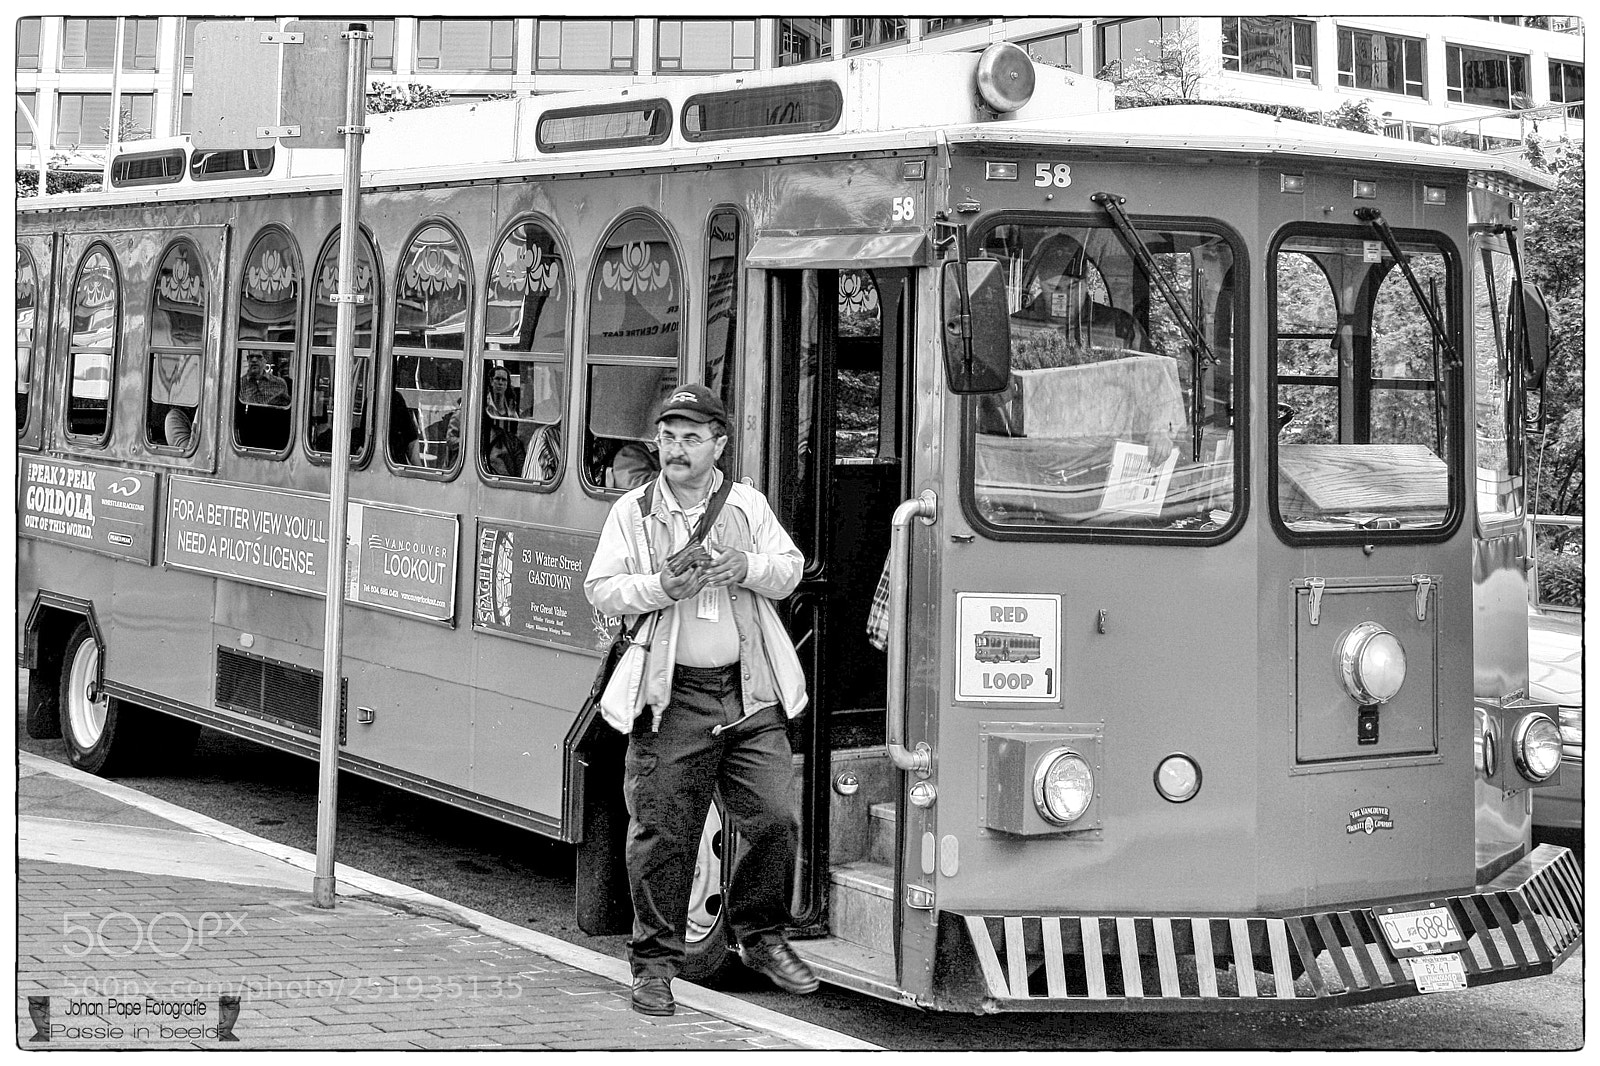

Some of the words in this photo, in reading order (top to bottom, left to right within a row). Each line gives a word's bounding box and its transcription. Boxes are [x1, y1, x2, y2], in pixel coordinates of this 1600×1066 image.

[1034, 163, 1072, 188] 58
[891, 196, 915, 221] 58
[746, 414, 757, 431] 58
[31, 463, 59, 485] PEAK
[57, 468, 66, 486] 2
[66, 468, 97, 491] PEAK
[25, 514, 40, 529] OUT
[40, 517, 49, 531] OF
[48, 519, 66, 534] THIS
[66, 522, 93, 540] WORLD.
[172, 499, 195, 522] FOR
[195, 502, 205, 523] A
[206, 503, 250, 530] BETTER
[252, 509, 283, 535] VIEW
[284, 514, 326, 544] YOU'LL
[177, 530, 207, 555] NEED
[208, 535, 218, 557] A
[219, 537, 261, 565] PILOT'S
[262, 544, 316, 576] LICENSE.
[384, 537, 448, 558] VANCOUVER
[384, 552, 447, 585] LOOKOUT
[522, 549, 532, 564] 53
[535, 551, 558, 568] Water
[559, 555, 583, 572] Street
[478, 528, 498, 623] SPAGHETTI
[528, 569, 572, 590] GASTOWN
[530, 601, 540, 612] For
[539, 603, 554, 615] Great
[553, 605, 568, 618] Value
[990, 605, 1028, 623] RED
[983, 672, 1034, 690] LOOP
[1045, 667, 1053, 695] 1
[1360, 807, 1389, 816] VANCOUVER
[1384, 920, 1411, 944] CL
[1415, 913, 1459, 940] 6884
[1425, 962, 1450, 975] 6247
